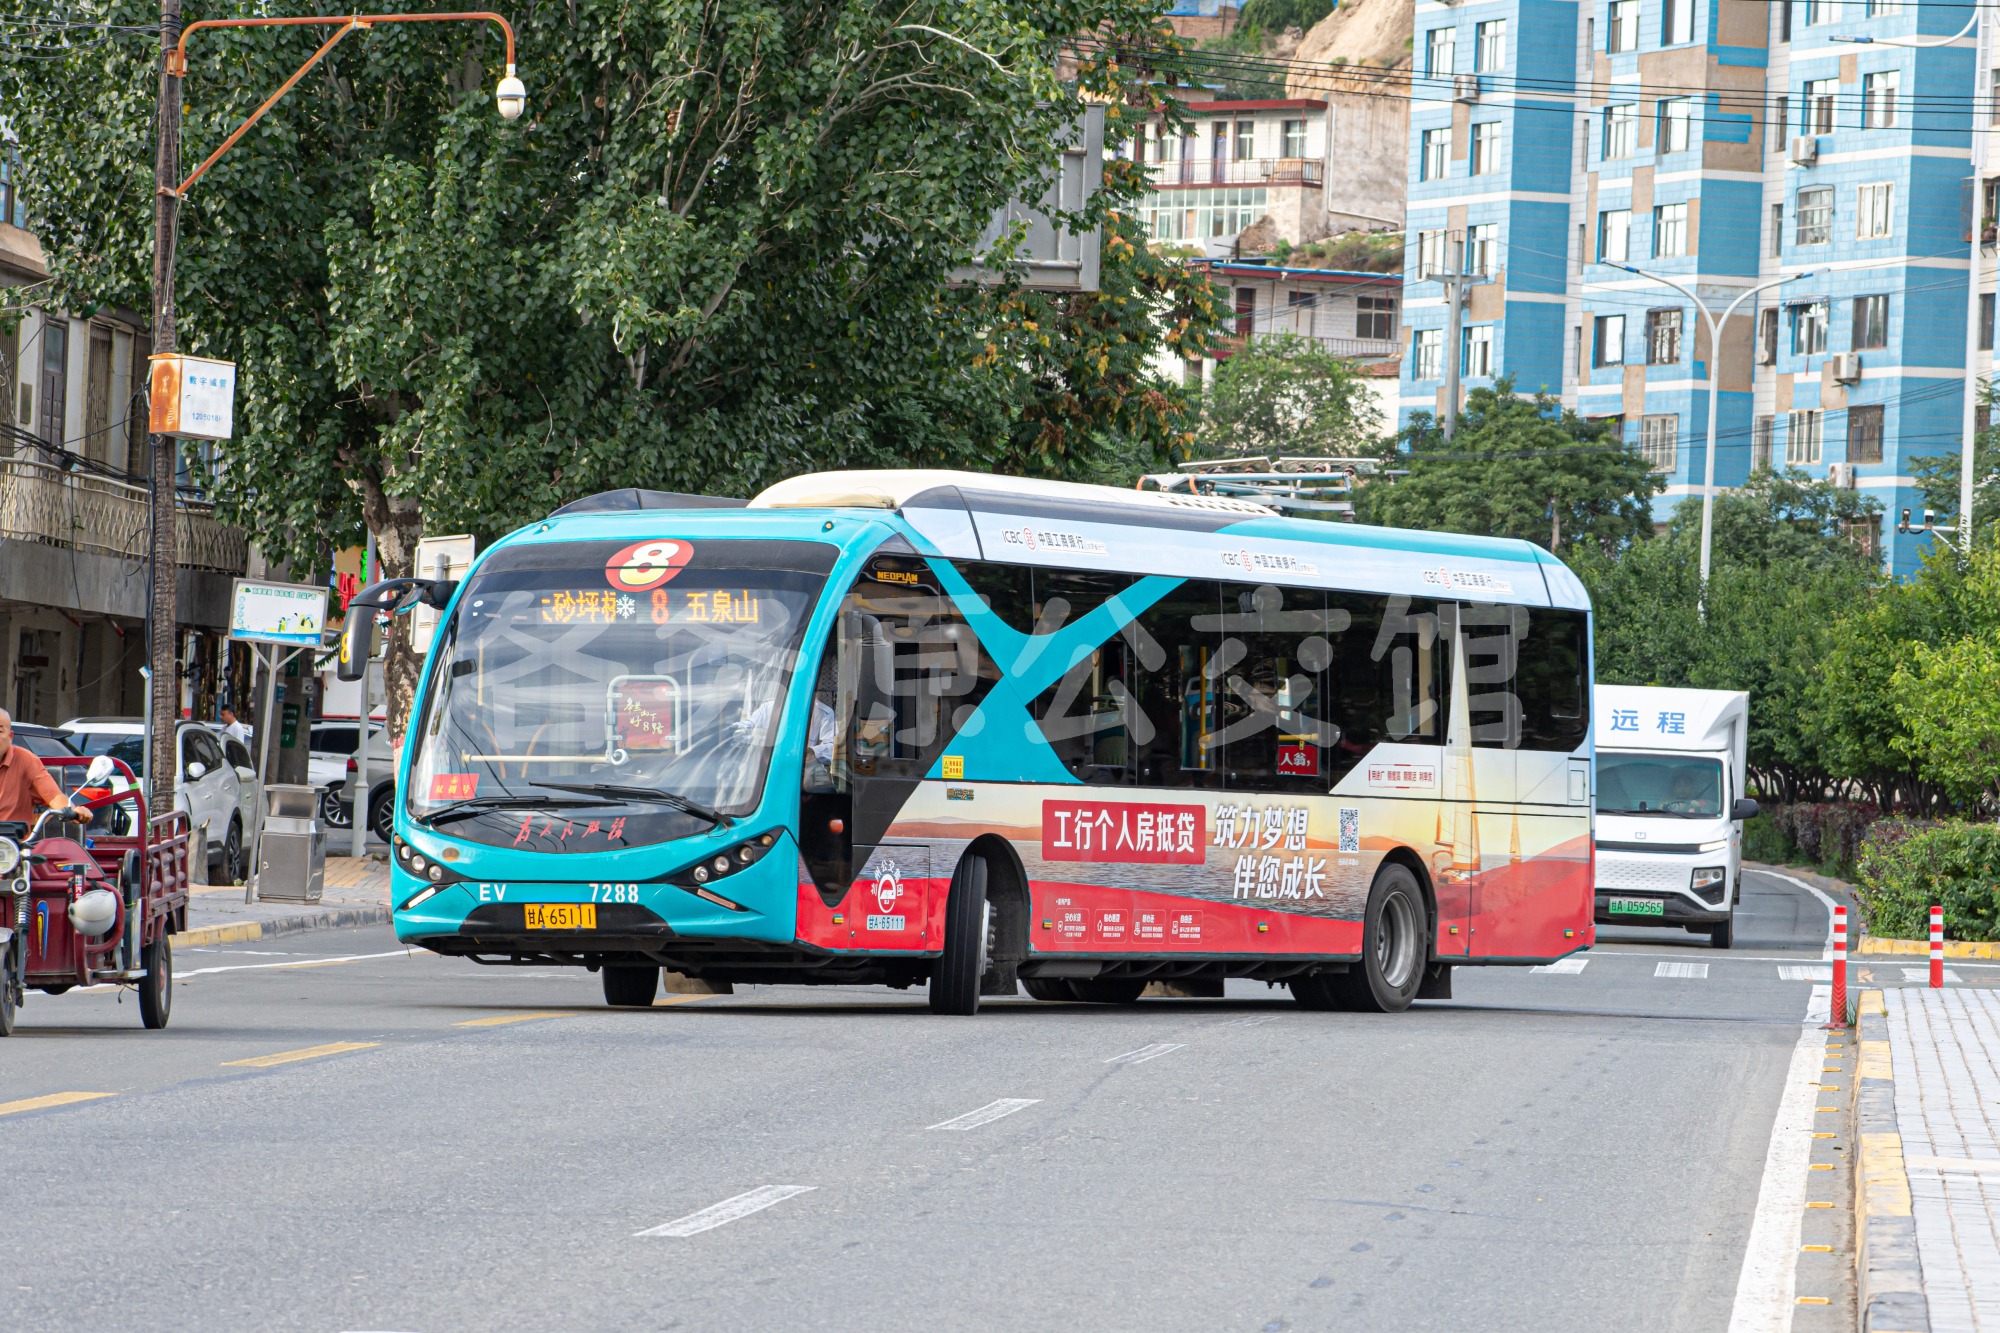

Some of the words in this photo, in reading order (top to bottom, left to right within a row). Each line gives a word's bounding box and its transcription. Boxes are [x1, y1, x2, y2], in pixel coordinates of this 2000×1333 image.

[1001, 530, 1023, 544] ICBC
[1037, 531, 1084, 549] 中国工商银行
[618, 542, 680, 586] 8
[1220, 552, 1241, 566] ICBC
[1254, 553, 1297, 571] 中国工商银行
[876, 571, 918, 584] NEOPLAN
[651, 587, 669, 625] 8
[686, 589, 759, 624] 五泉山
[340, 632, 351, 664] 8
[1610, 708, 1685, 735] 远程
[1053, 808, 1195, 853] 工行个人房抵贷
[1233, 854, 1327, 900] 伴您成长
[479, 883, 507, 902] EV
[589, 883, 639, 903] 7288
